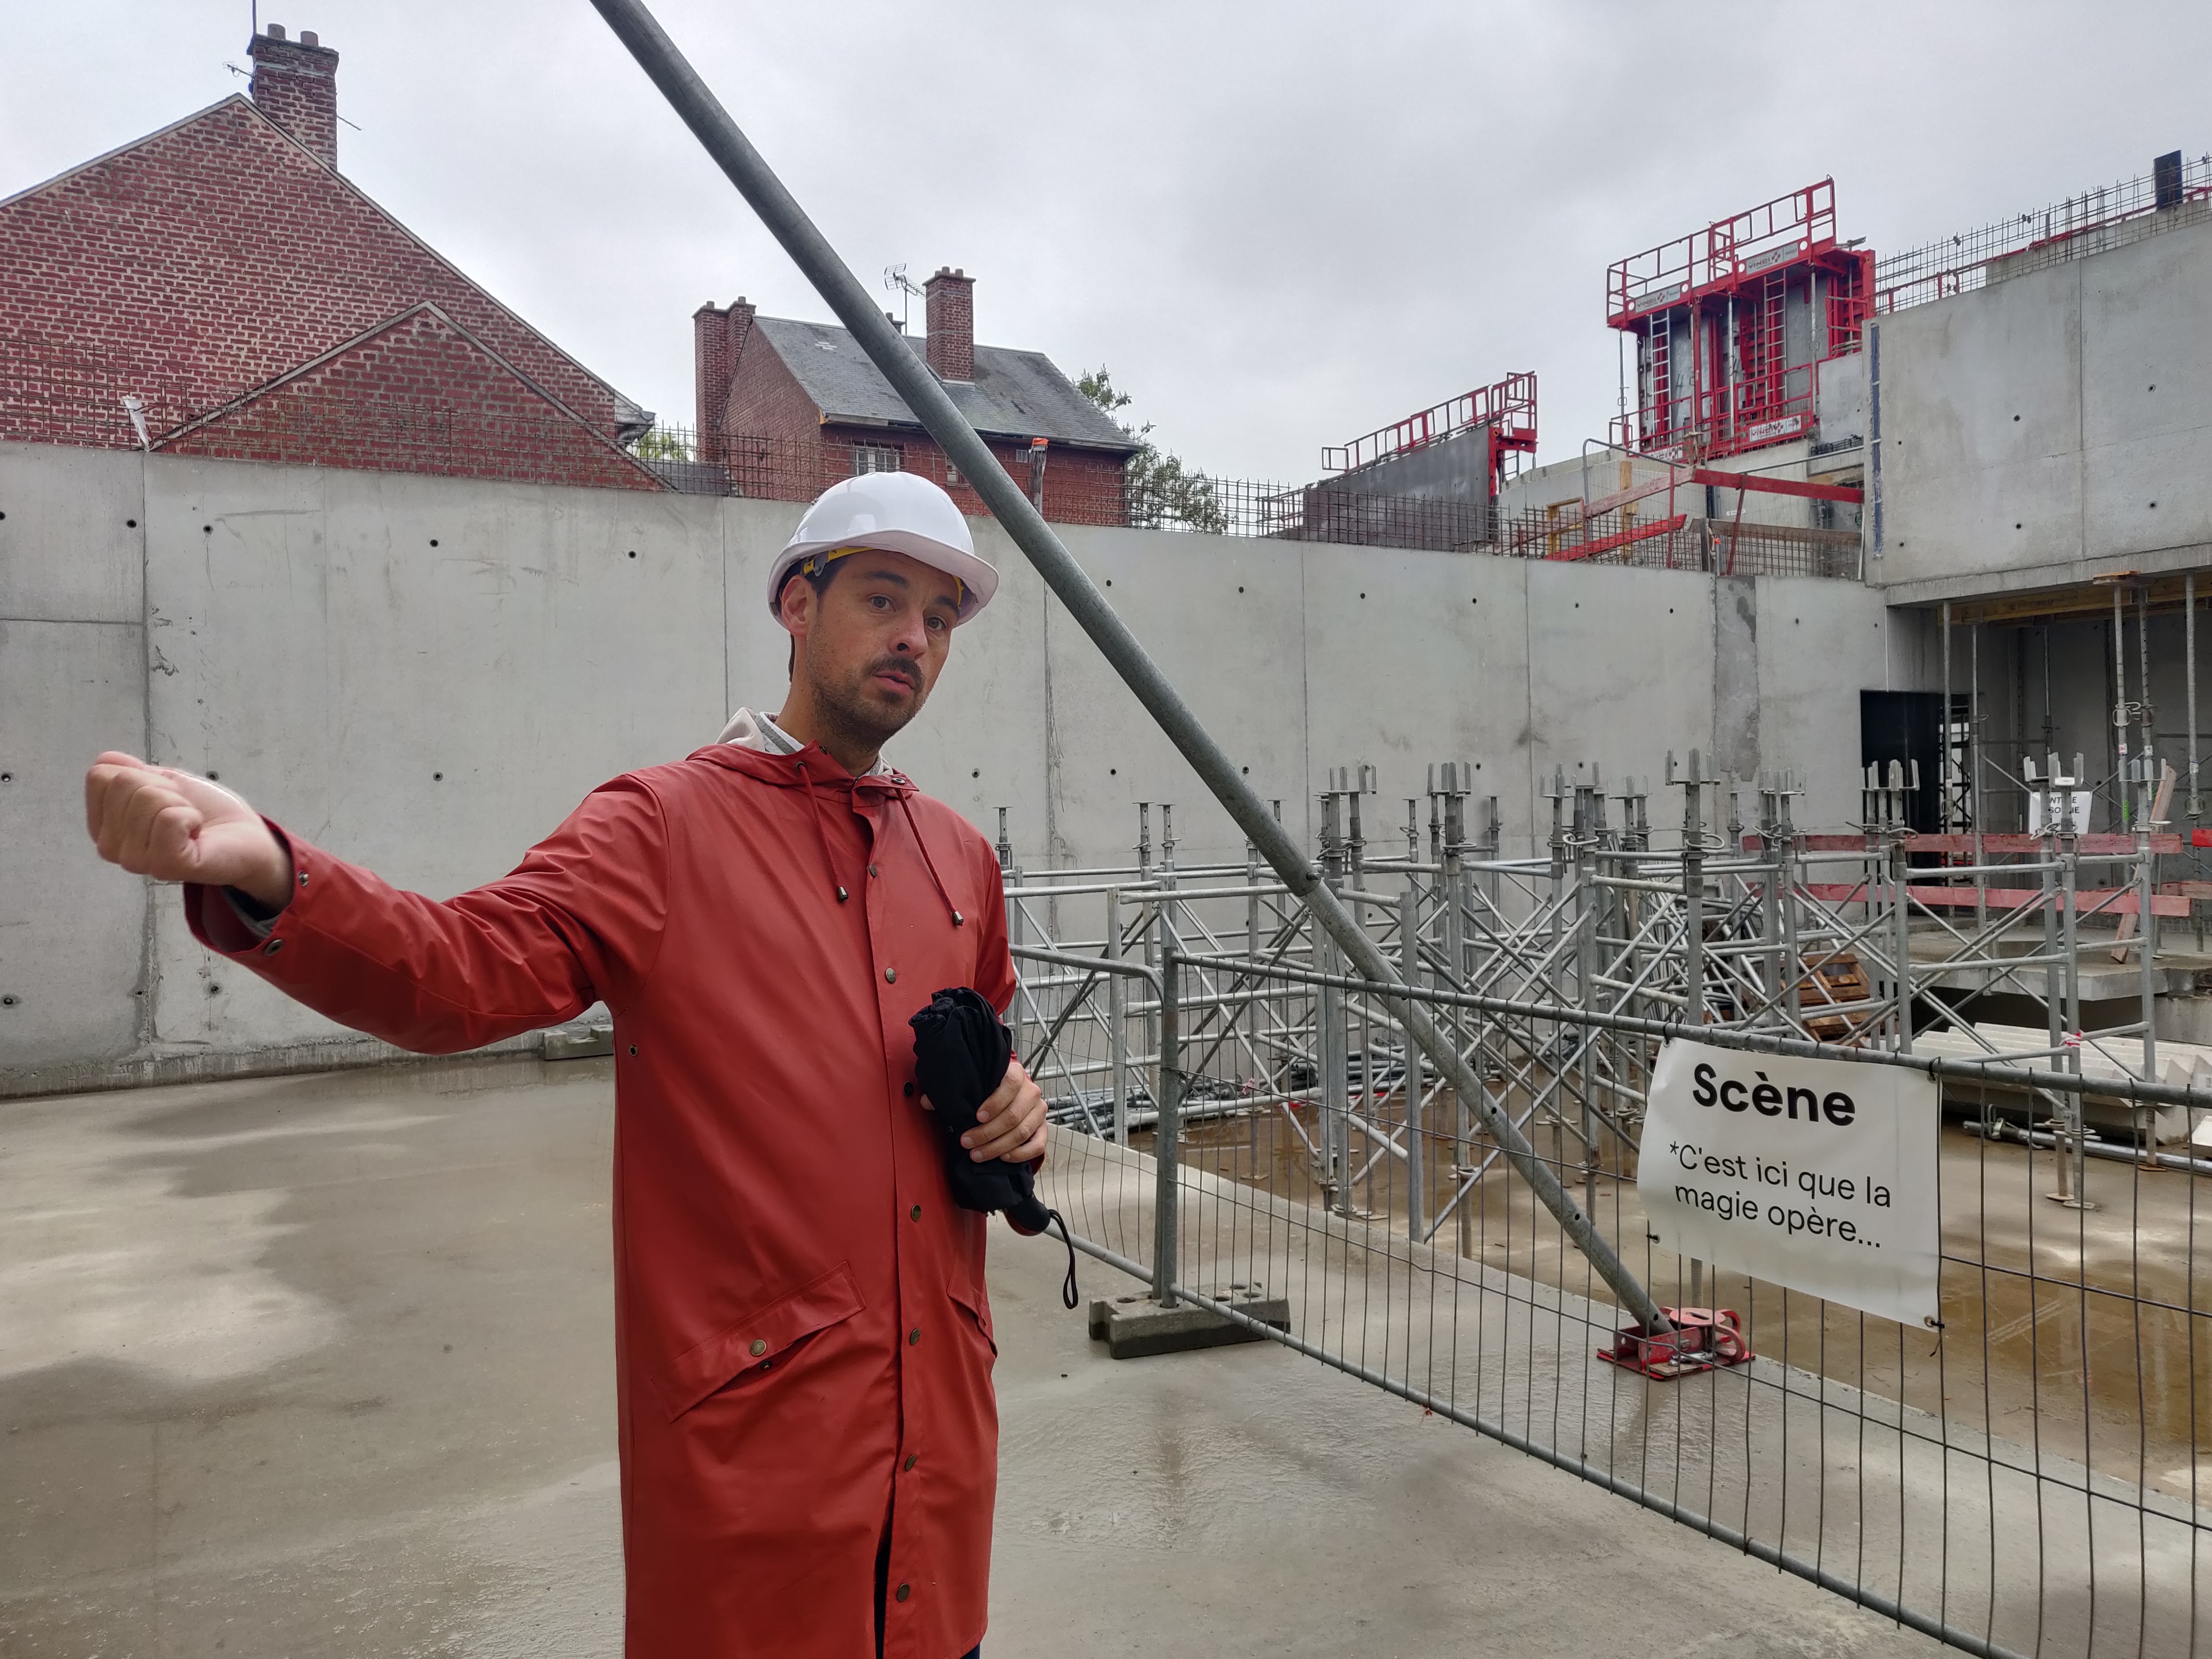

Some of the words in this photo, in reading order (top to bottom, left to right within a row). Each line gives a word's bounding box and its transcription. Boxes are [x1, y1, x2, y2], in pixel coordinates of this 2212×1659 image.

[1748, 258, 1771, 269] VINCI
[1692, 1062, 1856, 1126] Scène
[1756, 1156, 1788, 1187] ici
[1798, 1171, 1855, 1200] que
[1866, 1176, 1891, 1208] la
[1675, 1185, 1758, 1221] magie
[1767, 1205, 1881, 1248] opère...
